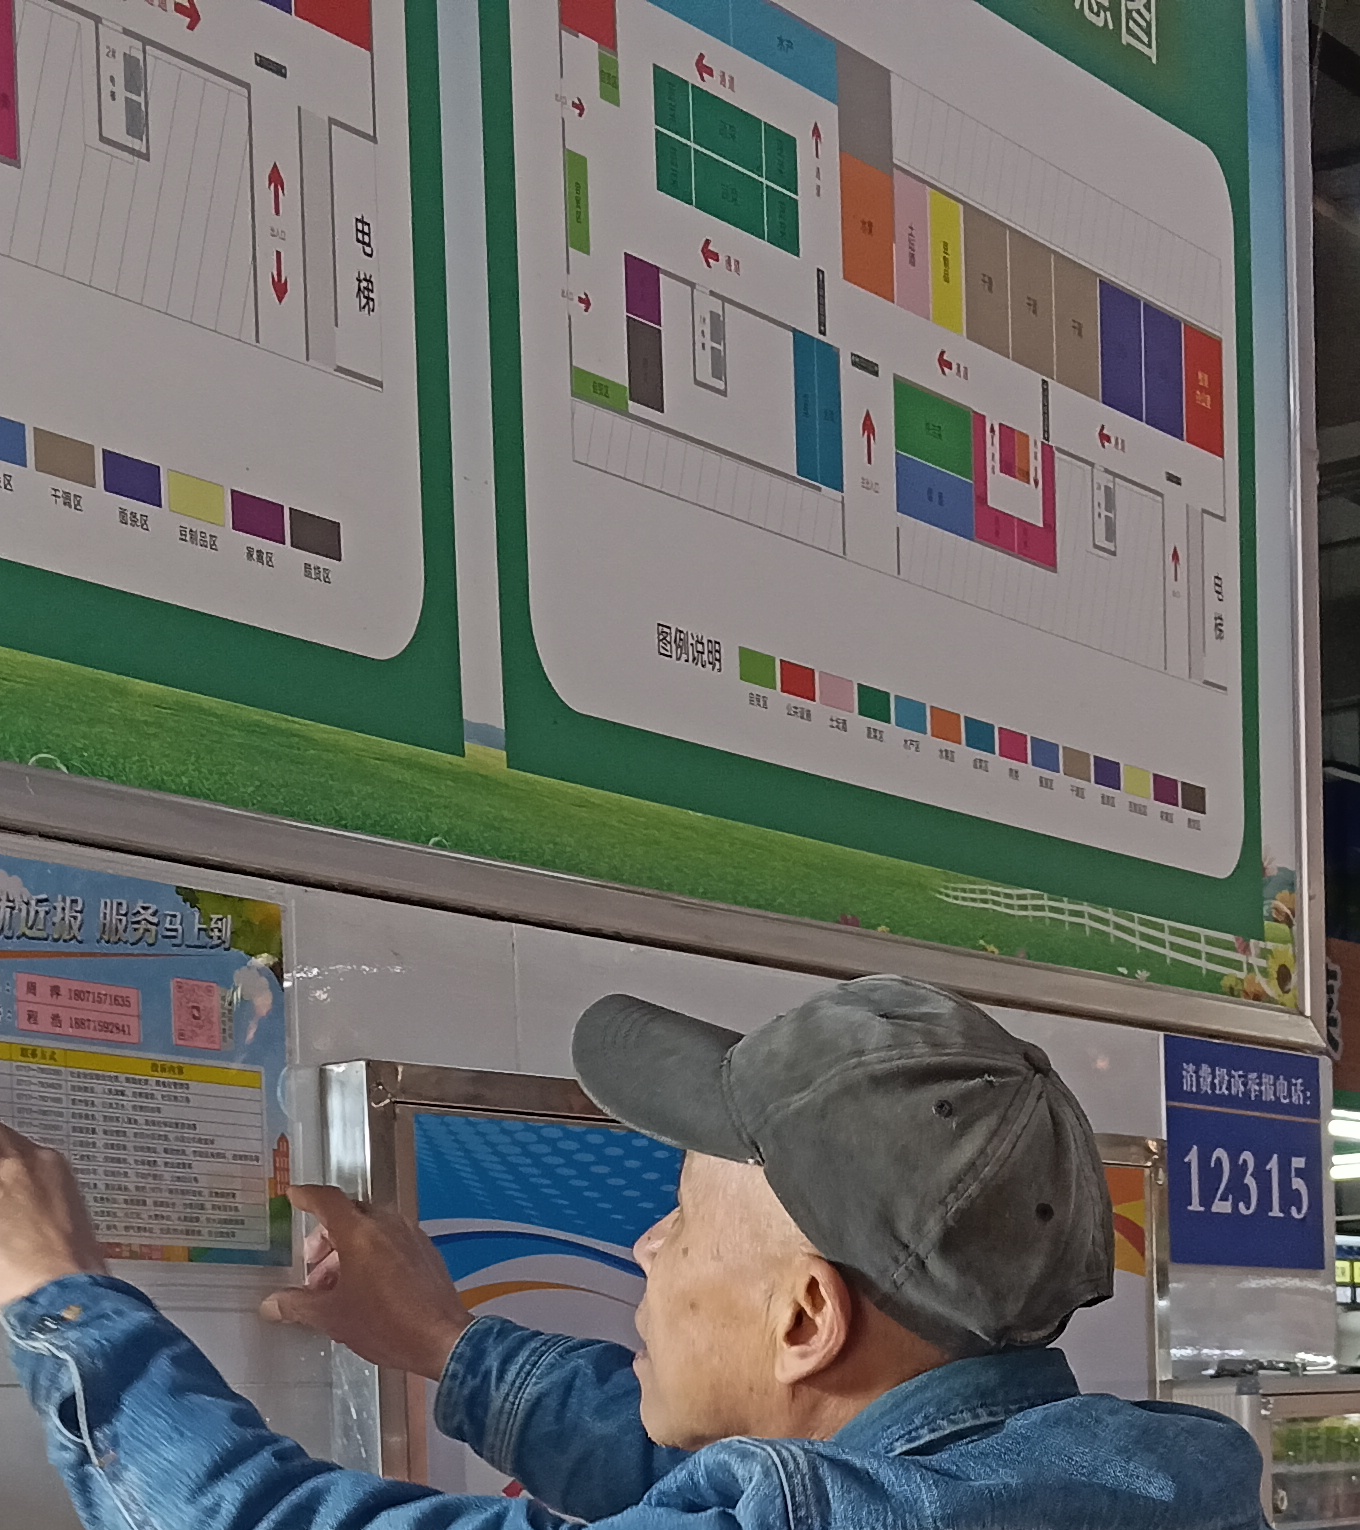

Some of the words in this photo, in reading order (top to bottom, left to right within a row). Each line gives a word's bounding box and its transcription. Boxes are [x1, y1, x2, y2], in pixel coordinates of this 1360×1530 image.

[354, 213, 375, 316] 电梯
[178, 525, 219, 552] 豆制品区
[656, 622, 722, 674] 图例说明
[97, 898, 234, 951] 服务马上到
[1183, 1143, 1310, 1220] 12315
